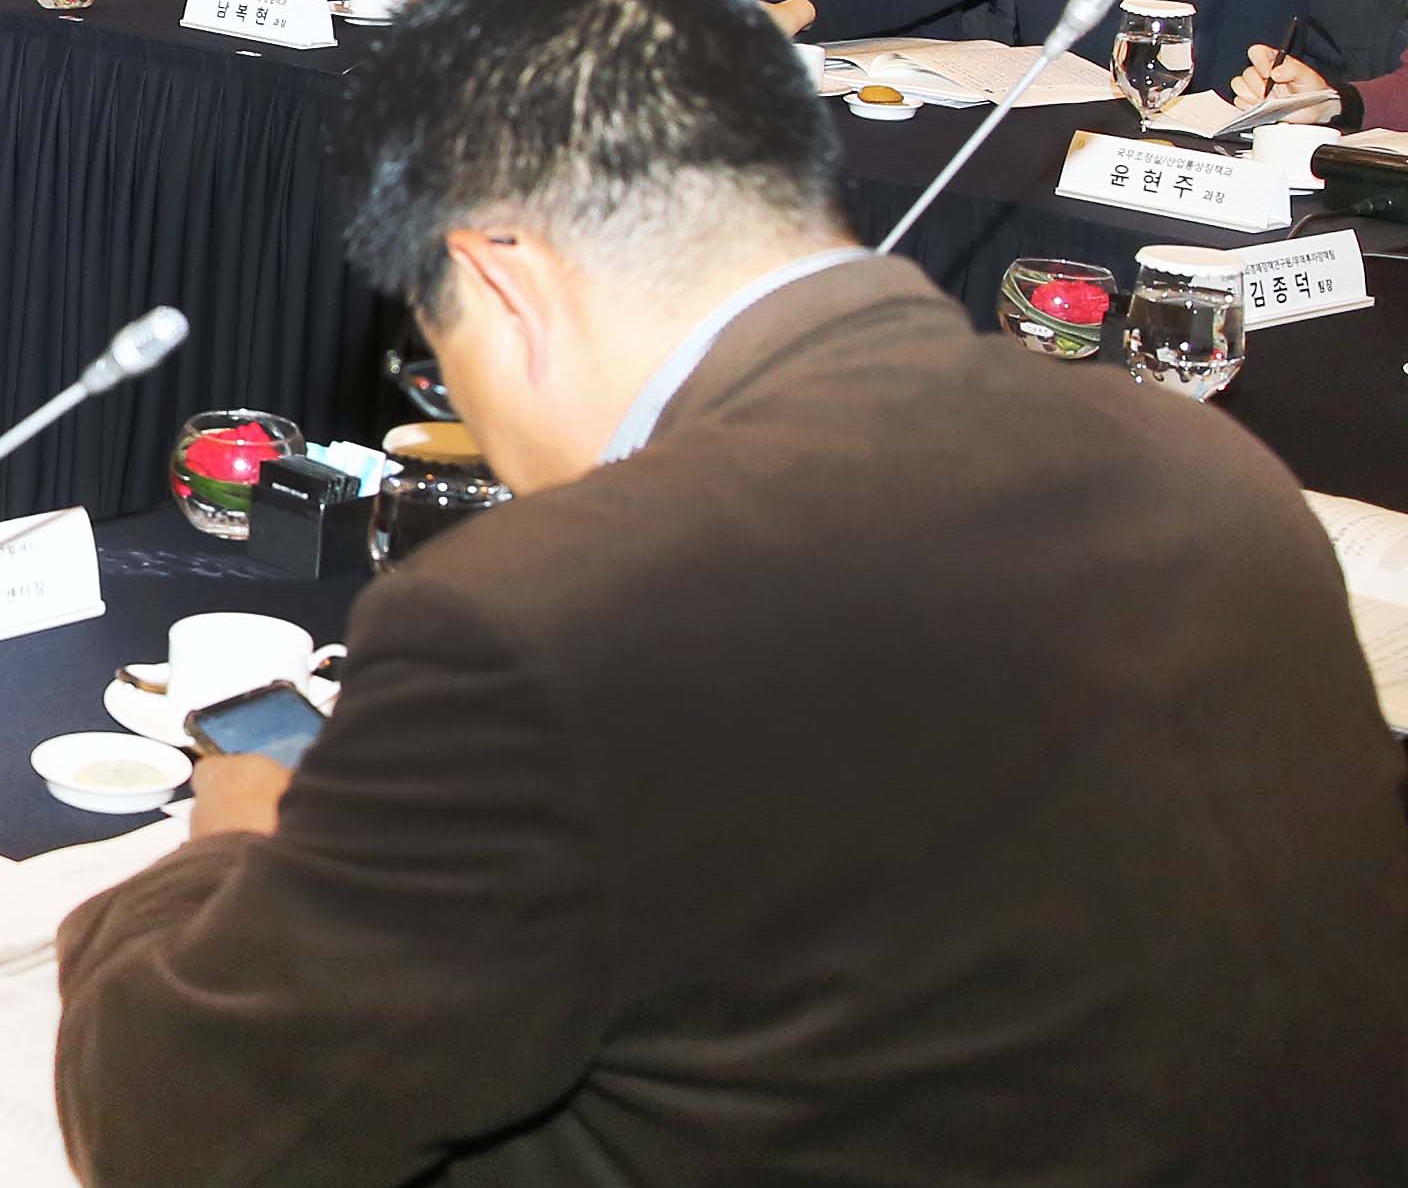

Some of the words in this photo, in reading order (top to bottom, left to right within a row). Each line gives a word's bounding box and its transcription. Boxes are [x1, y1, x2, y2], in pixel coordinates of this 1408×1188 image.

[1109, 163, 1194, 200] 윤현주
[1201, 189, 1226, 205] 과장
[1250, 271, 1311, 308] 김종덕
[1317, 278, 1333, 294] 팀장
